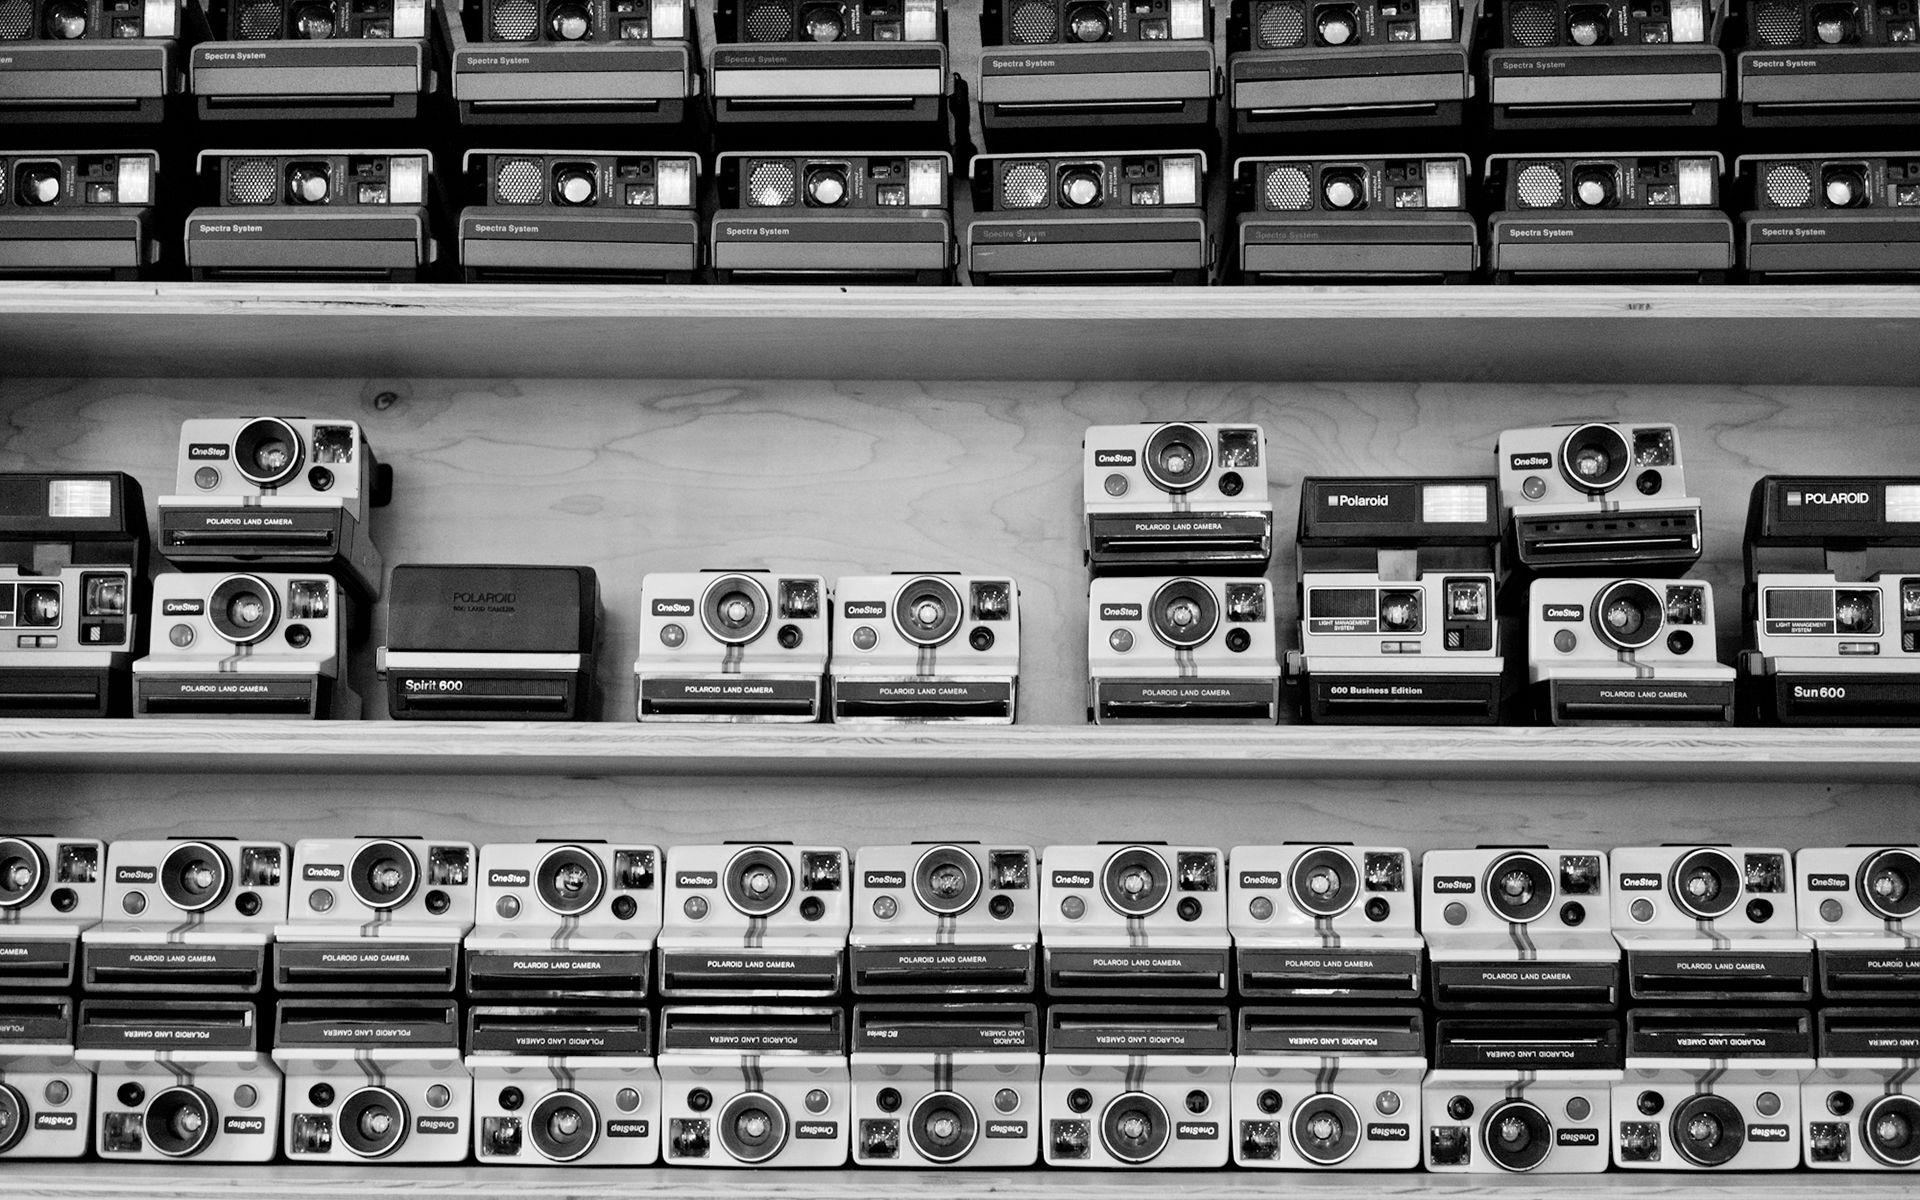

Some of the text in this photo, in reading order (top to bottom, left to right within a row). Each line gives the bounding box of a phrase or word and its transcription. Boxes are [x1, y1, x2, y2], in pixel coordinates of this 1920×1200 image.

[204, 52, 266, 62] Spectra System
[467, 56, 530, 66] Spectra System
[724, 55, 787, 64] Spectra System
[992, 59, 1056, 69] Spectra System
[1502, 61, 1566, 70] Spectra System
[1752, 59, 1817, 69] Spectra System
[199, 224, 263, 234] Spectra System
[475, 223, 539, 234] Spectra System
[726, 227, 790, 237] Spectra System
[1509, 228, 1574, 238] Spectra System
[1761, 227, 1826, 238] Spectra System
[191, 447, 226, 457] OneStep
[1098, 454, 1133, 464] OneStep
[1513, 456, 1549, 466] OneStep
[1339, 494, 1389, 507] Polaroid
[1805, 492, 1870, 504] POLAROID
[243, 518, 263, 526] LAND
[263, 518, 293, 526] CAMERA
[1135, 522, 1223, 531] POLAROID LAND CAMERA
[453, 592, 516, 603] POLAROID
[166, 602, 200, 612] OneStep
[656, 603, 691, 614] OneStep
[847, 605, 883, 616] OneStep
[1103, 607, 1139, 617] OneStep
[1547, 608, 1581, 618] OneStep
[180, 684, 269, 693] POLAROID LAND CAMERA
[405, 679, 463, 692] Spirit 600
[684, 685, 774, 694] POLAROID LAND CAMERA
[1330, 686, 1423, 695] 600 Business Edition
[879, 687, 916, 695] POLAROID
[1180, 689, 1200, 697] LAND
[1200, 689, 1231, 697] CAMERA
[1600, 690, 1636, 698] POLAROID
[1658, 691, 1688, 699] CAMERA
[119, 870, 154, 880] OneStep
[307, 867, 341, 878] OneStep
[491, 873, 527, 884] OneStep
[680, 876, 714, 886] OneStep
[867, 875, 903, 885] OneStep
[1054, 874, 1090, 886] OneStep
[1243, 875, 1278, 885] OneStep
[1623, 877, 1659, 888] OneStep
[1811, 877, 1846, 888] OneStep
[1436, 880, 1472, 890] OneStep
[0, 948, 29, 956] CAMERA
[129, 954, 165, 962] POLAROID
[187, 955, 217, 963] CAMERA
[322, 954, 410, 962] POLAROID LAND CAMERA
[898, 955, 987, 964] POLAROID LAND CAMERA
[1093, 958, 1129, 966] POLAROID
[1152, 959, 1182, 967] CAMERA
[513, 961, 602, 970] POLAROID LAND CAMERA
[707, 960, 796, 969] POLAROID LAND CAMERA
[1284, 960, 1374, 968] POLAROID LAND CAMERA
[1676, 962, 1713, 970] POLAROID
[1735, 962, 1766, 970] CAMERA
[1867, 960, 1904, 968] POLAROID
[1482, 972, 1518, 980] POLAROID
[1541, 972, 1572, 980] CAMERA
[124, 1030, 210, 1039] POLAROID LAND CAMERA
[322, 1029, 353, 1037] CAMERA
[375, 1029, 412, 1037] POLAROID
[866, 1030, 899, 1038] BC Series
[516, 1037, 604, 1046] POLAROID LAND CAMERA
[709, 1036, 798, 1044] POLAROID LAND CAMERA
[992, 1037, 1025, 1045] POLAROID
[1096, 1036, 1185, 1044] POLAROID LAND CAMERA
[1288, 1037, 1378, 1046] POLAROID LAND CAMERA
[1676, 1038, 1766, 1046] POLAROID LAND CAMERA
[1486, 1050, 1575, 1058] POLAROID LAND CAMERA
[38, 1115, 74, 1126] OneStep
[227, 1119, 263, 1130] OneStep
[419, 1119, 456, 1130] OneStep
[610, 1123, 646, 1134] OneStep
[800, 1124, 834, 1135] OneStep
[990, 1124, 1024, 1134] OneStep
[1179, 1125, 1215, 1136] OneStep
[1370, 1126, 1407, 1137] OneStep
[1750, 1127, 1787, 1138] OneStep
[1560, 1132, 1596, 1142] OneStep
